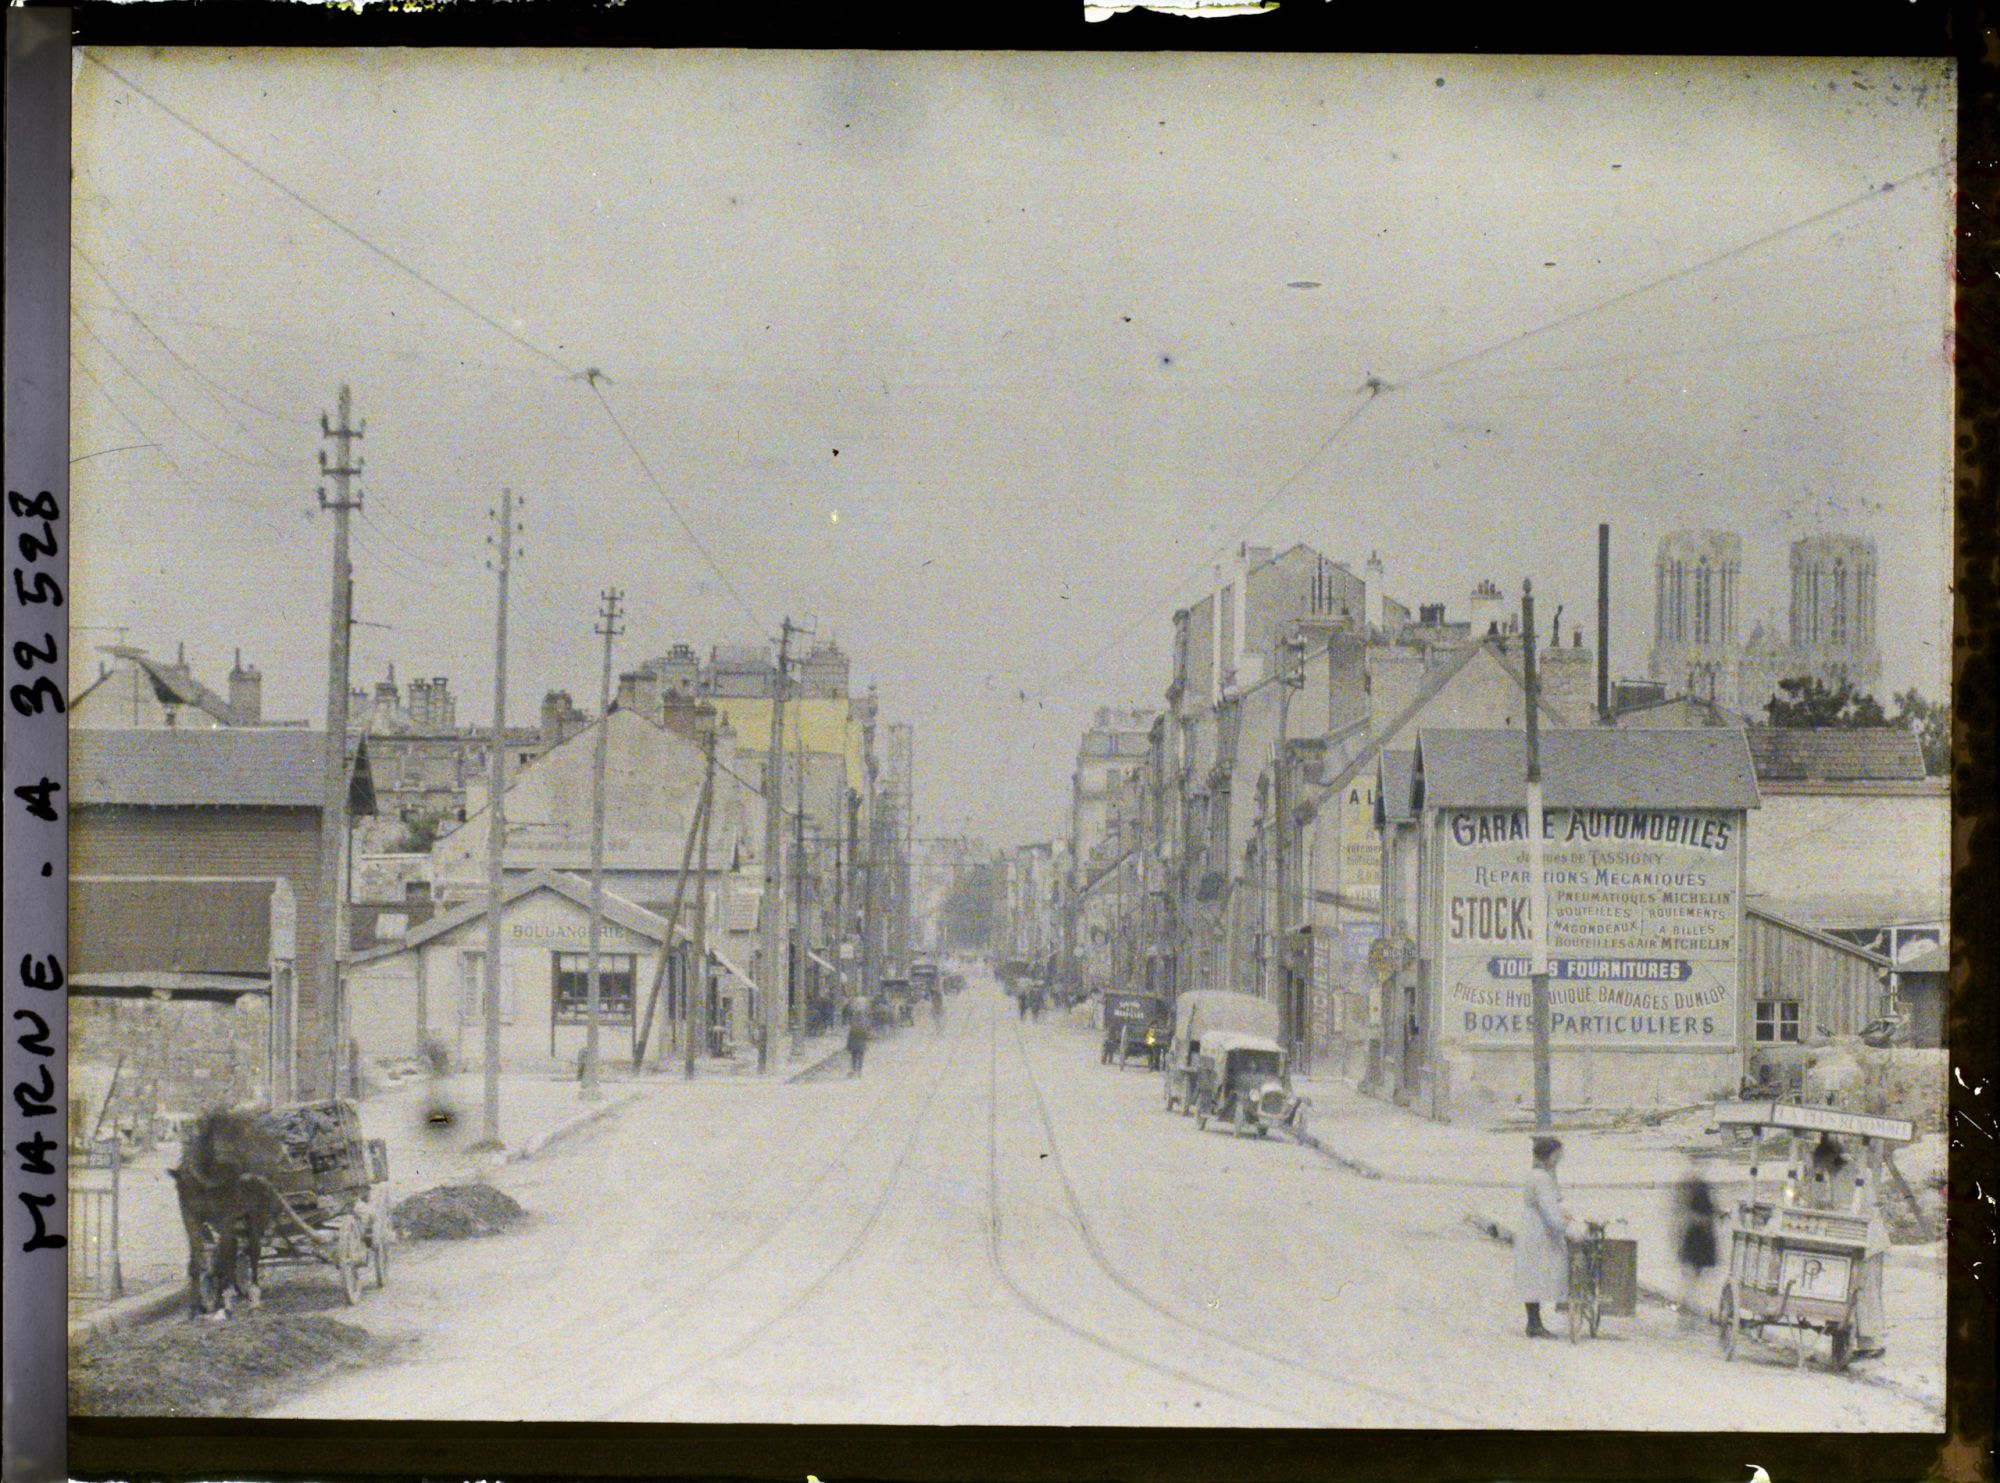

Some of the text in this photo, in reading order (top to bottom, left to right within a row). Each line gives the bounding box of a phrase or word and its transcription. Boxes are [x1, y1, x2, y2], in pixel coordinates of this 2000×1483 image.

[14, 777, 61, 821] A
[1565, 808, 1732, 850] AUTOMOBILES
[1475, 867, 1707, 886] REPARTIONS MECANIQUES
[1558, 891, 1655, 905] PNEUMATIQUES
[1649, 908, 1726, 920] ROULEMENTS
[513, 924, 625, 939] BOULANGRIE
[1673, 924, 1715, 935] BILLES
[1498, 960, 1681, 979] TOUS FOURNITURES
[1311, 936, 1328, 1045] OUCHERIE
[1454, 982, 1726, 1010] PRESSE HYDULIQUE BANDAGES DUNLOP
[1464, 1011, 1715, 1035] BOXES PARTICULIERS
[13, 954, 66, 1253] MARNE
